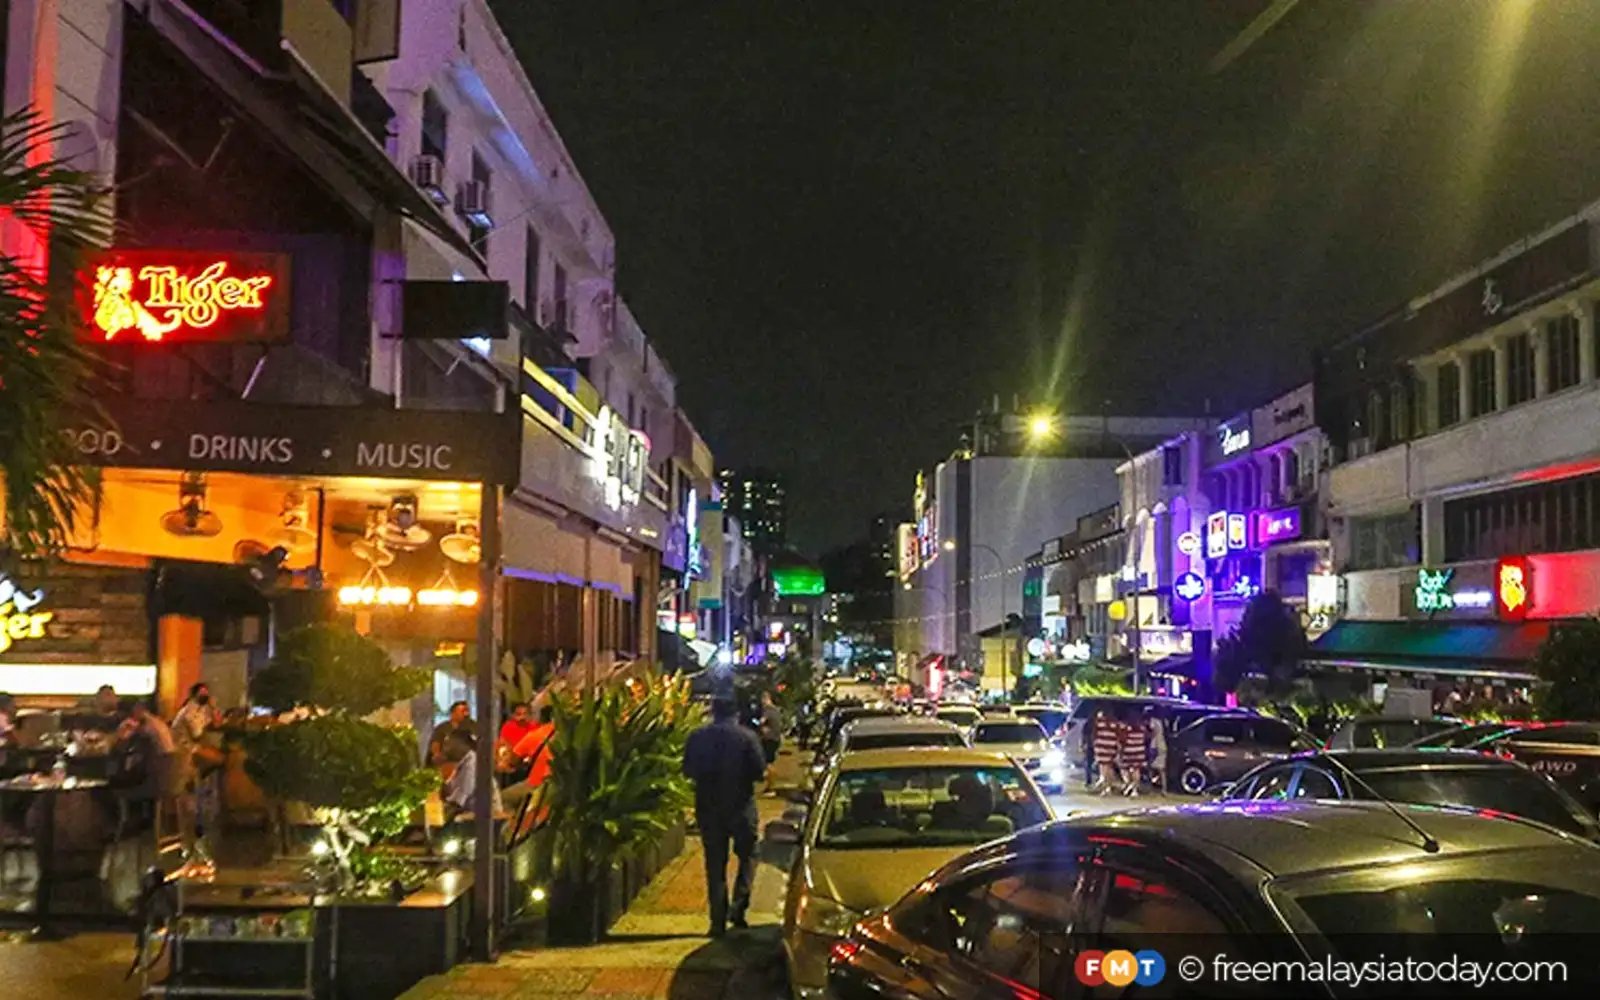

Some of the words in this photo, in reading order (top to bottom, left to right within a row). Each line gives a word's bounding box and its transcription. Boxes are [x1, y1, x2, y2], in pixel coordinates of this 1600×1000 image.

[139, 261, 271, 327] Tiger
[188, 434, 293, 463] DRINKS
[356, 441, 451, 470] MUSIC
